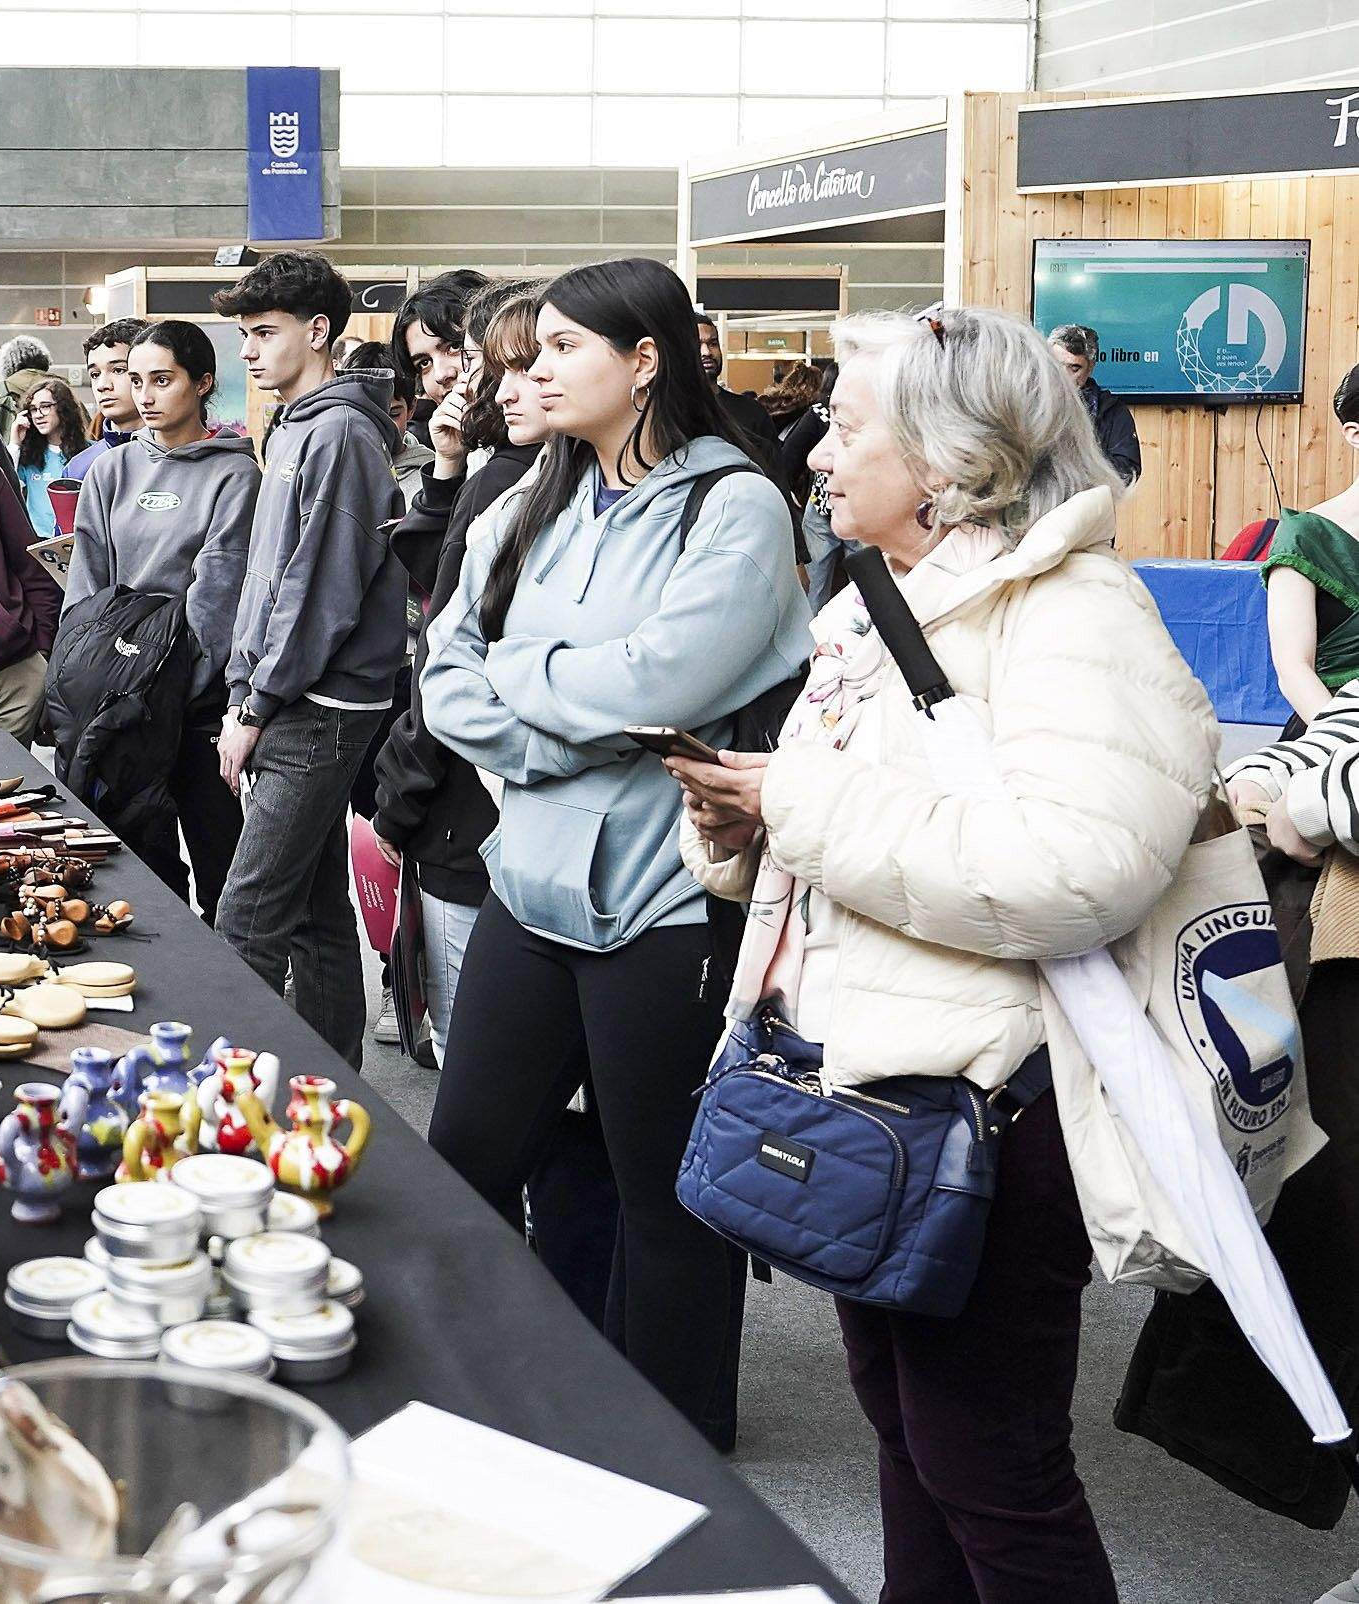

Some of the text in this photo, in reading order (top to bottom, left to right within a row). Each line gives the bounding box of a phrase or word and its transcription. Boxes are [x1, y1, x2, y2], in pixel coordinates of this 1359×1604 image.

[1325, 92, 1359, 147] F
[747, 160, 875, 216] Concello de Catoira
[1111, 348, 1140, 362] libro
[1143, 350, 1159, 362] en
[1181, 942, 1197, 1001] UNHA
[1217, 1067, 1232, 1101] UN
[1226, 1096, 1267, 1128] FUTURO
